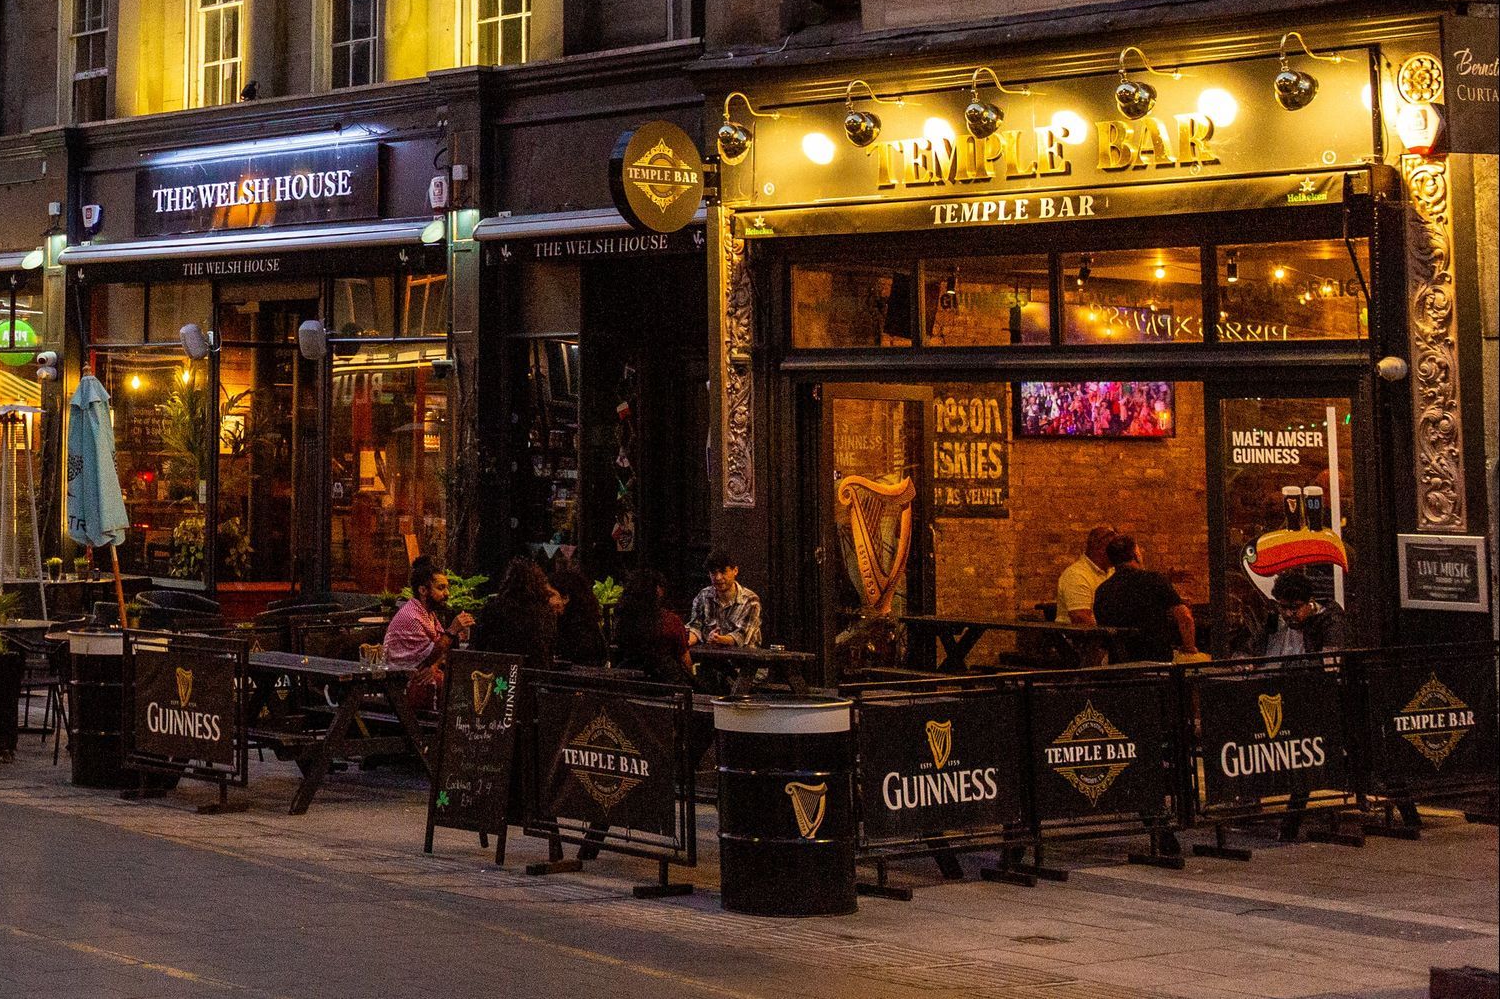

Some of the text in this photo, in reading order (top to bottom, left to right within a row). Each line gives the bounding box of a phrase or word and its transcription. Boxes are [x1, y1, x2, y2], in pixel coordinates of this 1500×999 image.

[867, 112, 1218, 187] TEMPLE BAR
[626, 167, 698, 183] TEMPLE BAR
[152, 170, 352, 212] THE WELSH HOUSE
[930, 195, 1095, 225] TEMPLE BAR
[534, 234, 668, 257] THE WELSH HOUSE
[182, 258, 280, 276] THE WELSH HOUSE
[1232, 431, 1323, 447] MAE'N AMSER
[1233, 448, 1300, 464] GUINNESS
[945, 487, 960, 505] AS
[964, 487, 1004, 505] VELVET.
[1417, 560, 1469, 578] LIVE MUSIC
[503, 664, 518, 729] GUINNESS
[147, 702, 221, 742] GUINNESS
[1393, 711, 1475, 731] TEMPLE BAR
[562, 748, 650, 777] TEMPLE BAR
[1044, 743, 1137, 764] TEMPLE BAR
[1221, 736, 1325, 778] GUINNESS
[882, 767, 997, 810] GUINNESS
